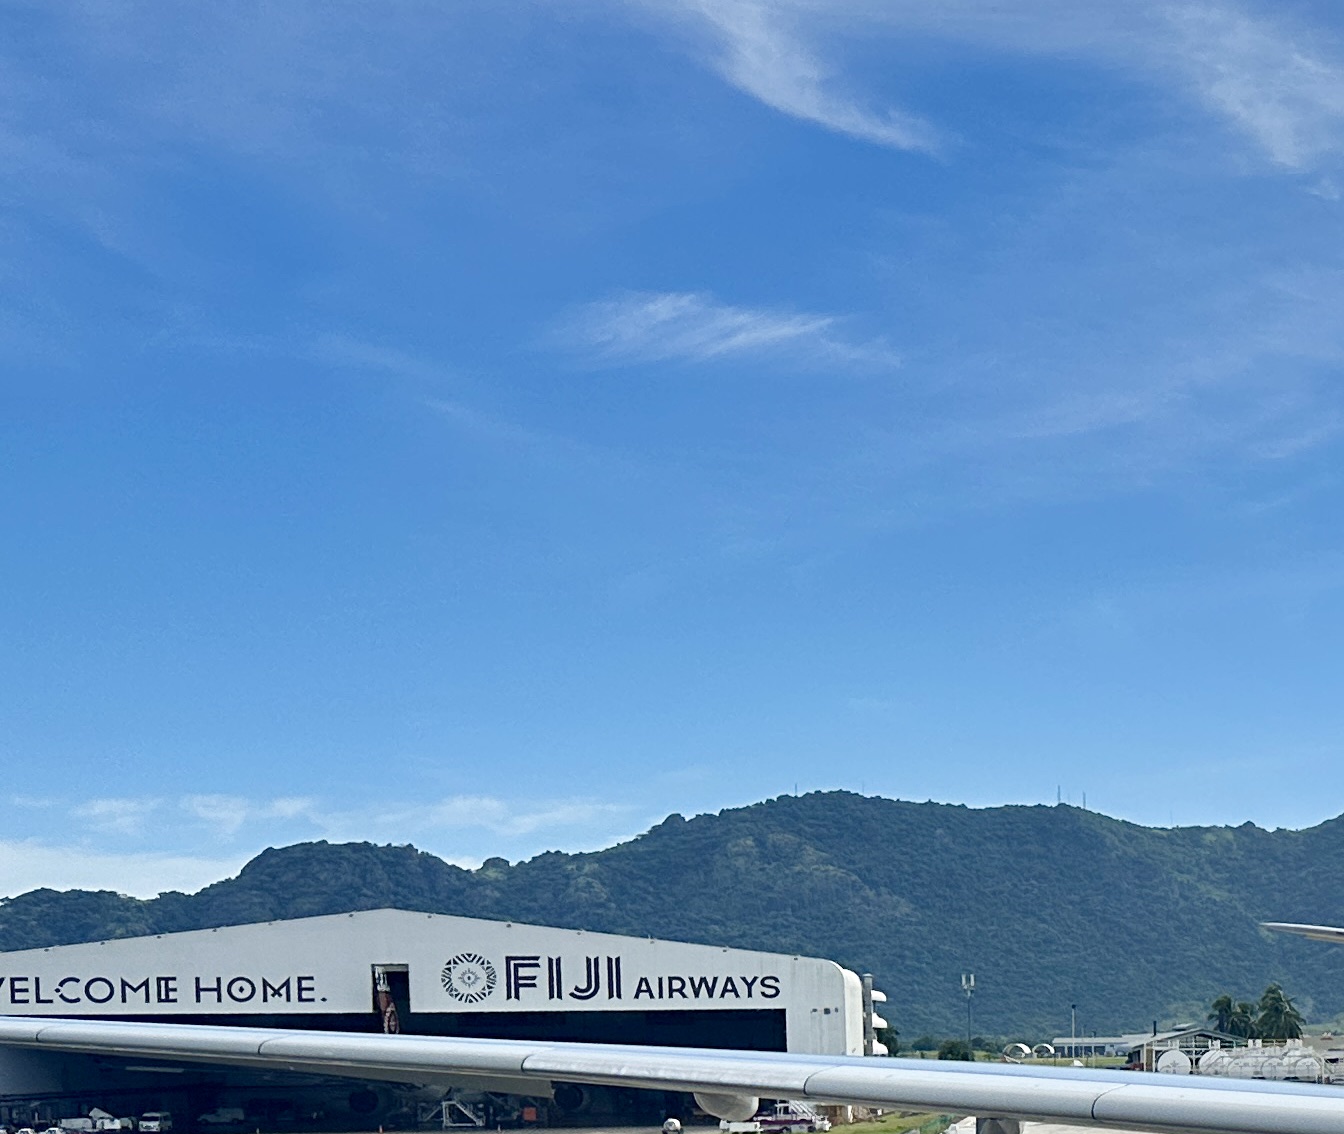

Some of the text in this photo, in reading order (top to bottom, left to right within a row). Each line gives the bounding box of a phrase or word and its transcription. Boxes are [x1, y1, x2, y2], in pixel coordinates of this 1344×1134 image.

[0, 976, 328, 1003] ELCOME HOME.
[505, 955, 781, 1000] FIJI AIRWAYS
